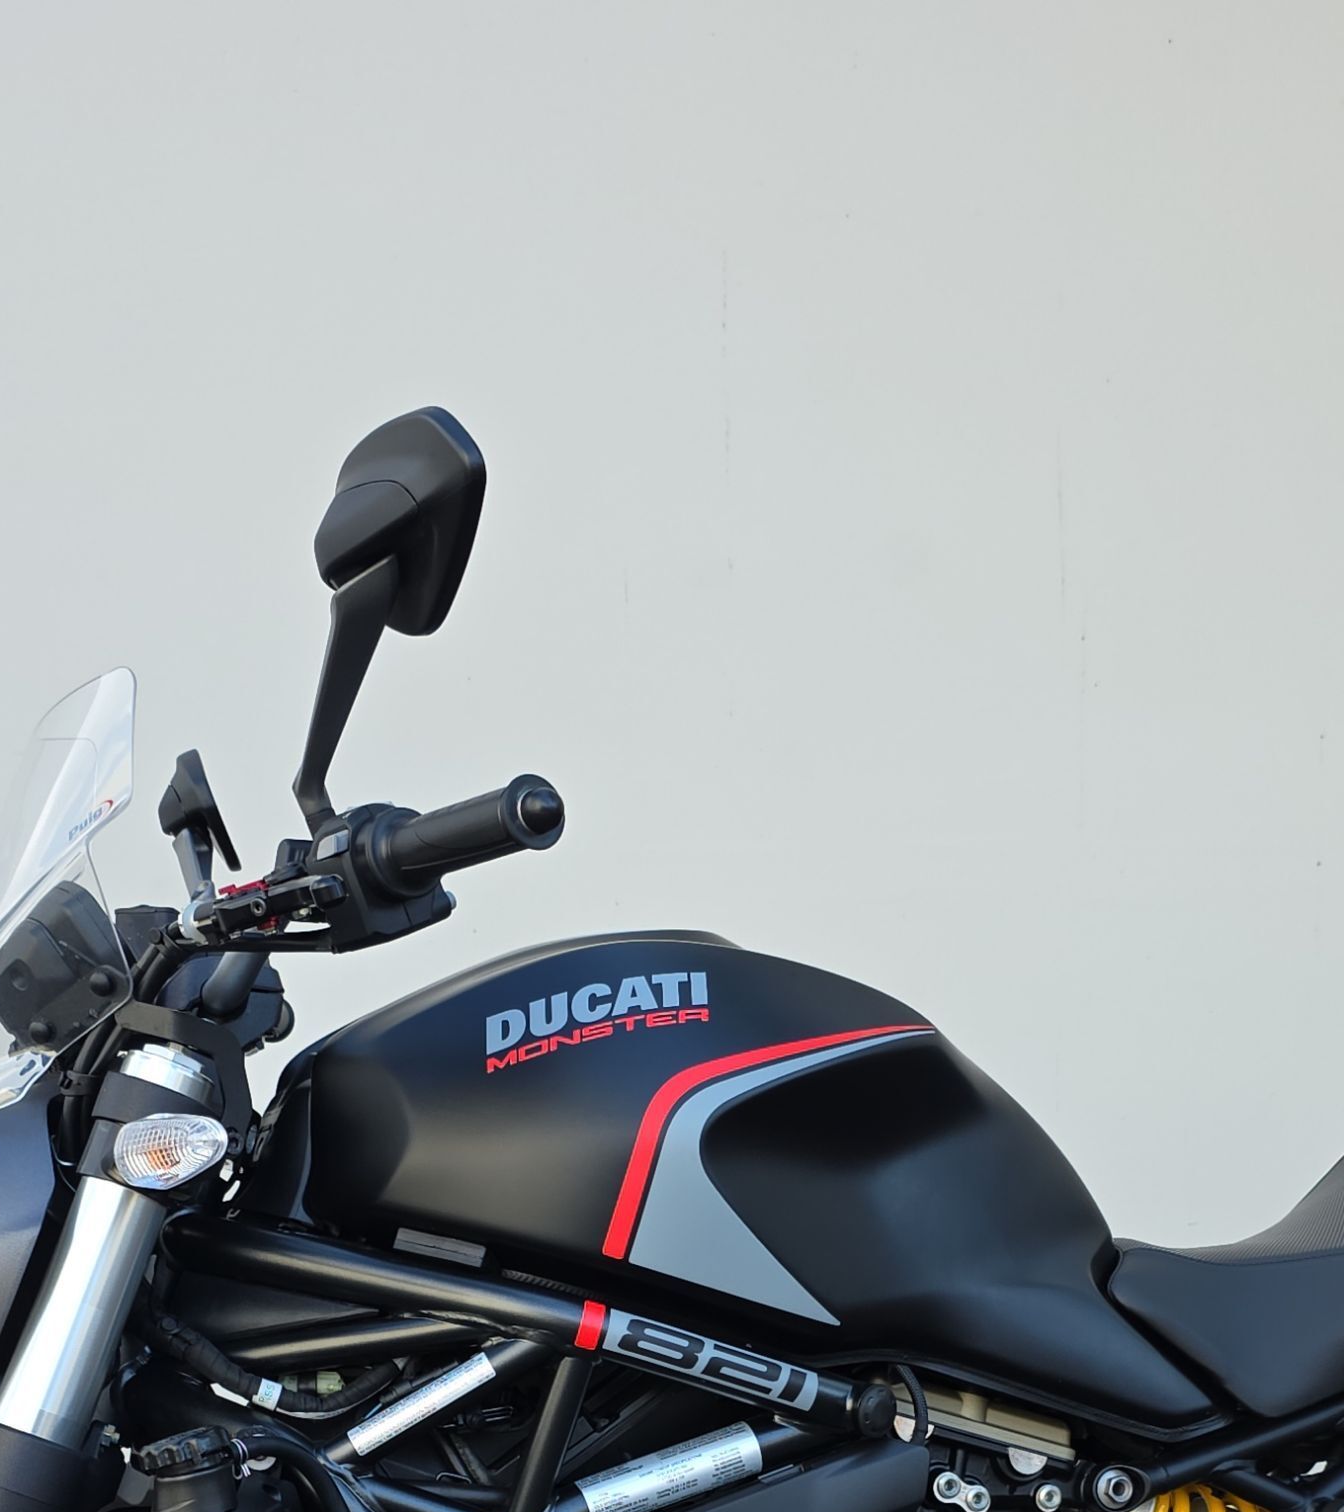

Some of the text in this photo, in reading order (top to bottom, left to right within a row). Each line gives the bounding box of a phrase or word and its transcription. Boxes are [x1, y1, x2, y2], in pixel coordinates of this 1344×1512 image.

[486, 971, 708, 1055] DUCATI
[486, 1008, 709, 1073] MONSTER
[617, 1318, 808, 1403] 821
